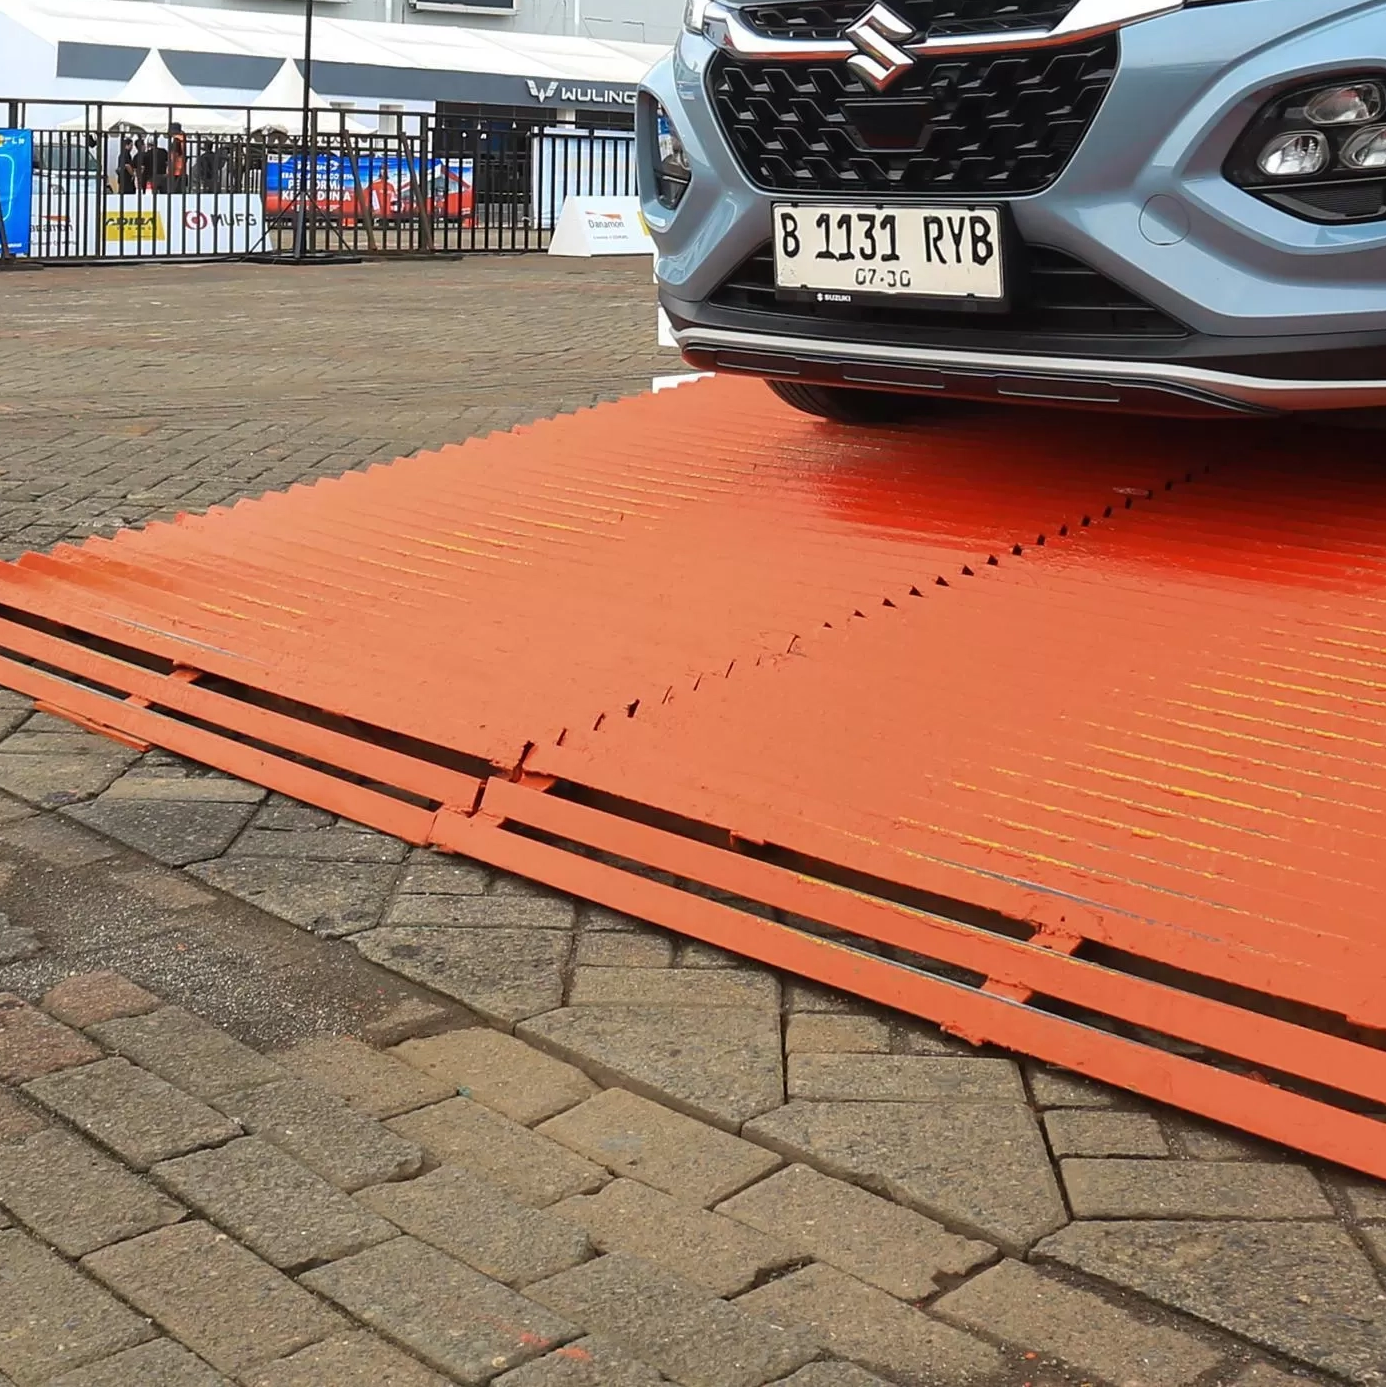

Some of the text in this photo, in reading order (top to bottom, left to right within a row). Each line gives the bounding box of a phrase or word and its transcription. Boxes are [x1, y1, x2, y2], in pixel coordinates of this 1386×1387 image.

[561, 87, 638, 104] WULING
[588, 219, 625, 229] Danamon
[780, 212, 994, 266] B 1131 RYB
[824, 294, 852, 303] SUZUKI
